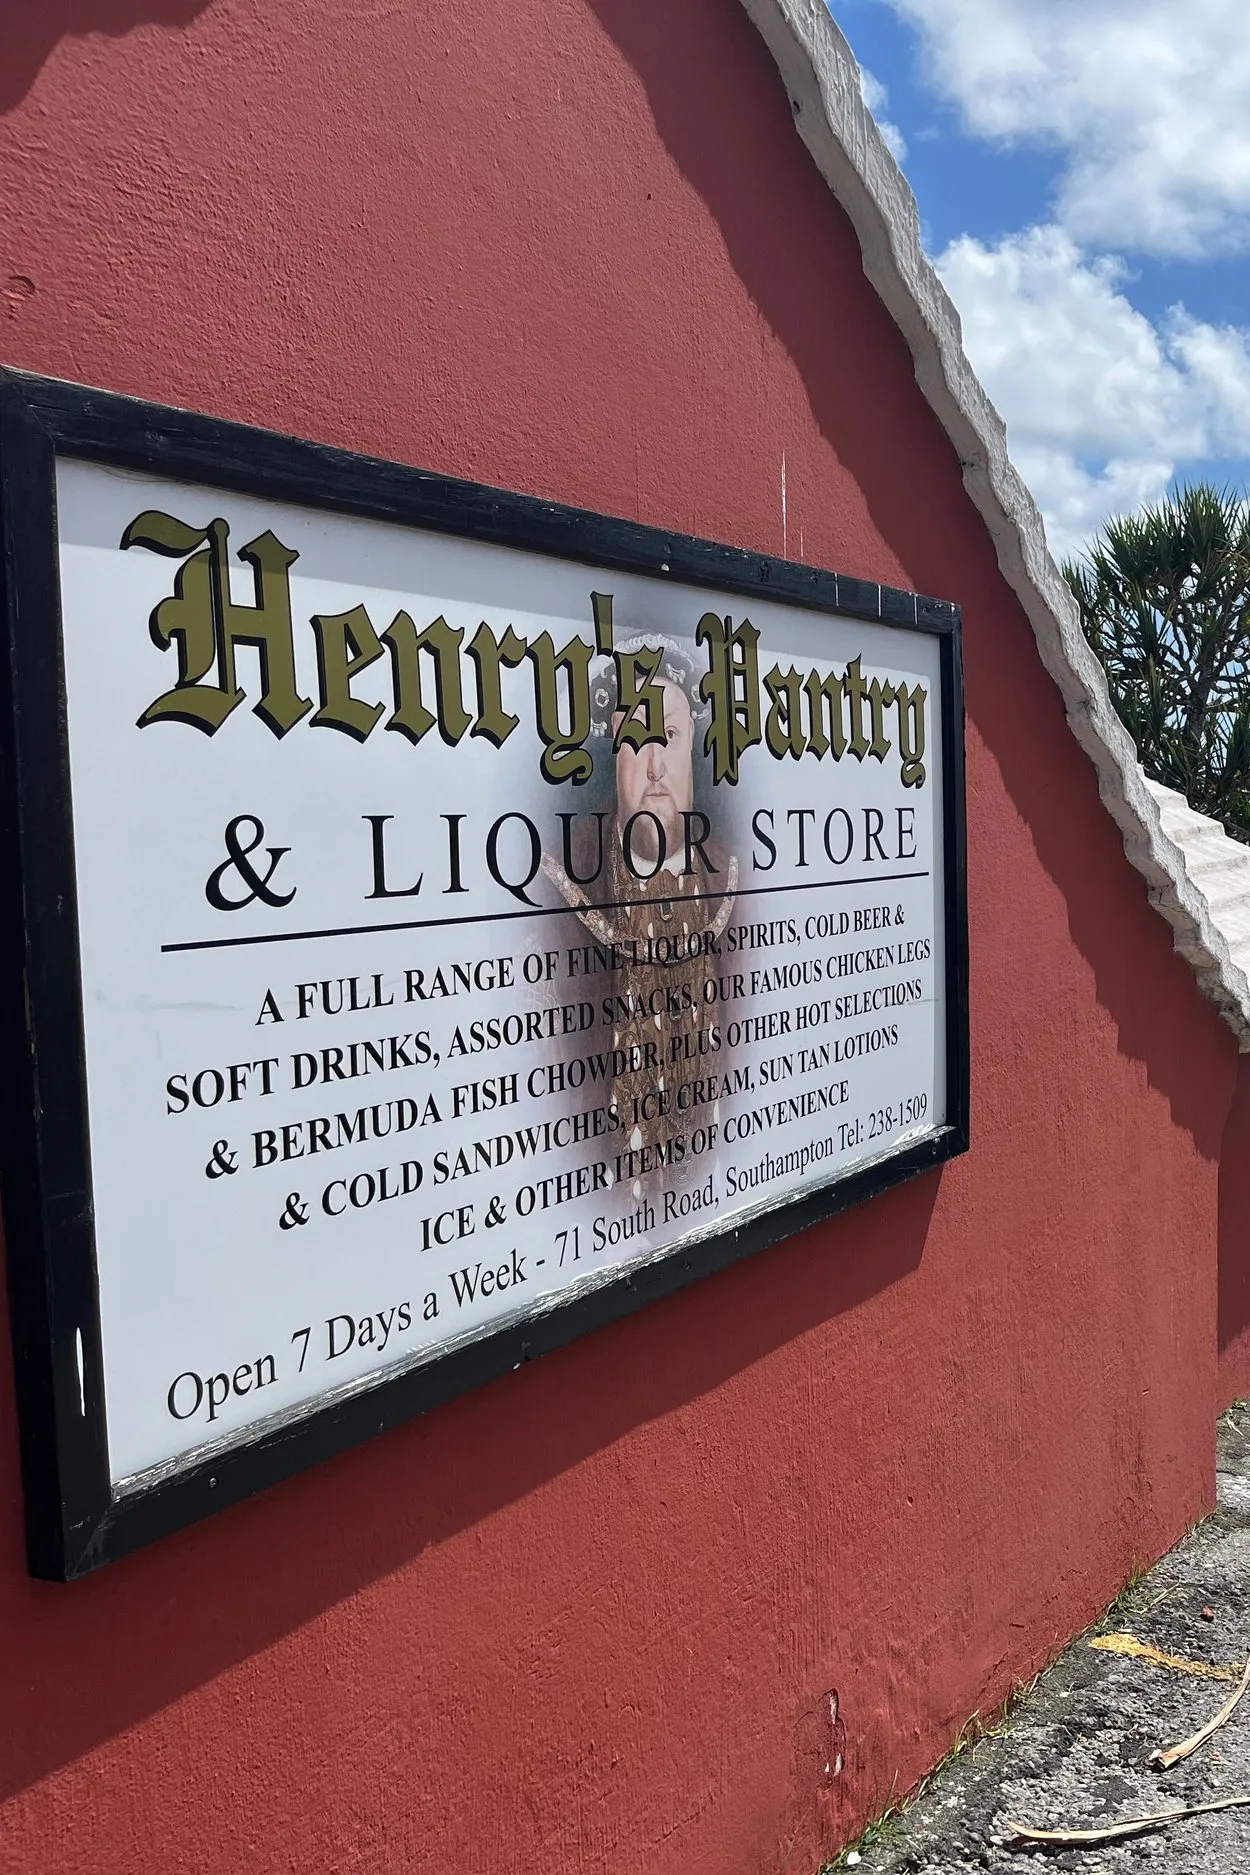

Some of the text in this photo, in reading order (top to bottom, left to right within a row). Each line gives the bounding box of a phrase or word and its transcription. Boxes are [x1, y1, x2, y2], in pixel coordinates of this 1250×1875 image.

[119, 510, 928, 789] Henry's Pantry
[205, 807, 918, 911] & LIQUOR STORE
[165, 938, 931, 1115] SOFT DRINKS, ASSORTED SNACKS, OUR FAMOUS CHICKEN LEGS
[255, 904, 905, 1026] A FULL RANGE OF FINE LIQUOR, SPIRITS, COLD BEER &
[204, 978, 923, 1180] & BERMUDA FISH CHOWDER, PLUS OTHER HOT SELECTIONS
[278, 1024, 899, 1231] & COLD SANDWICHES, ICE CREAM, SUN TAN LOTIONS
[420, 1080, 849, 1252] ICE & OTHER ITEMS OF CONVENIENCE
[167, 1093, 928, 1423] Open 7 Days a Week - 71 South Road, Southampton Tel: 238-1509
